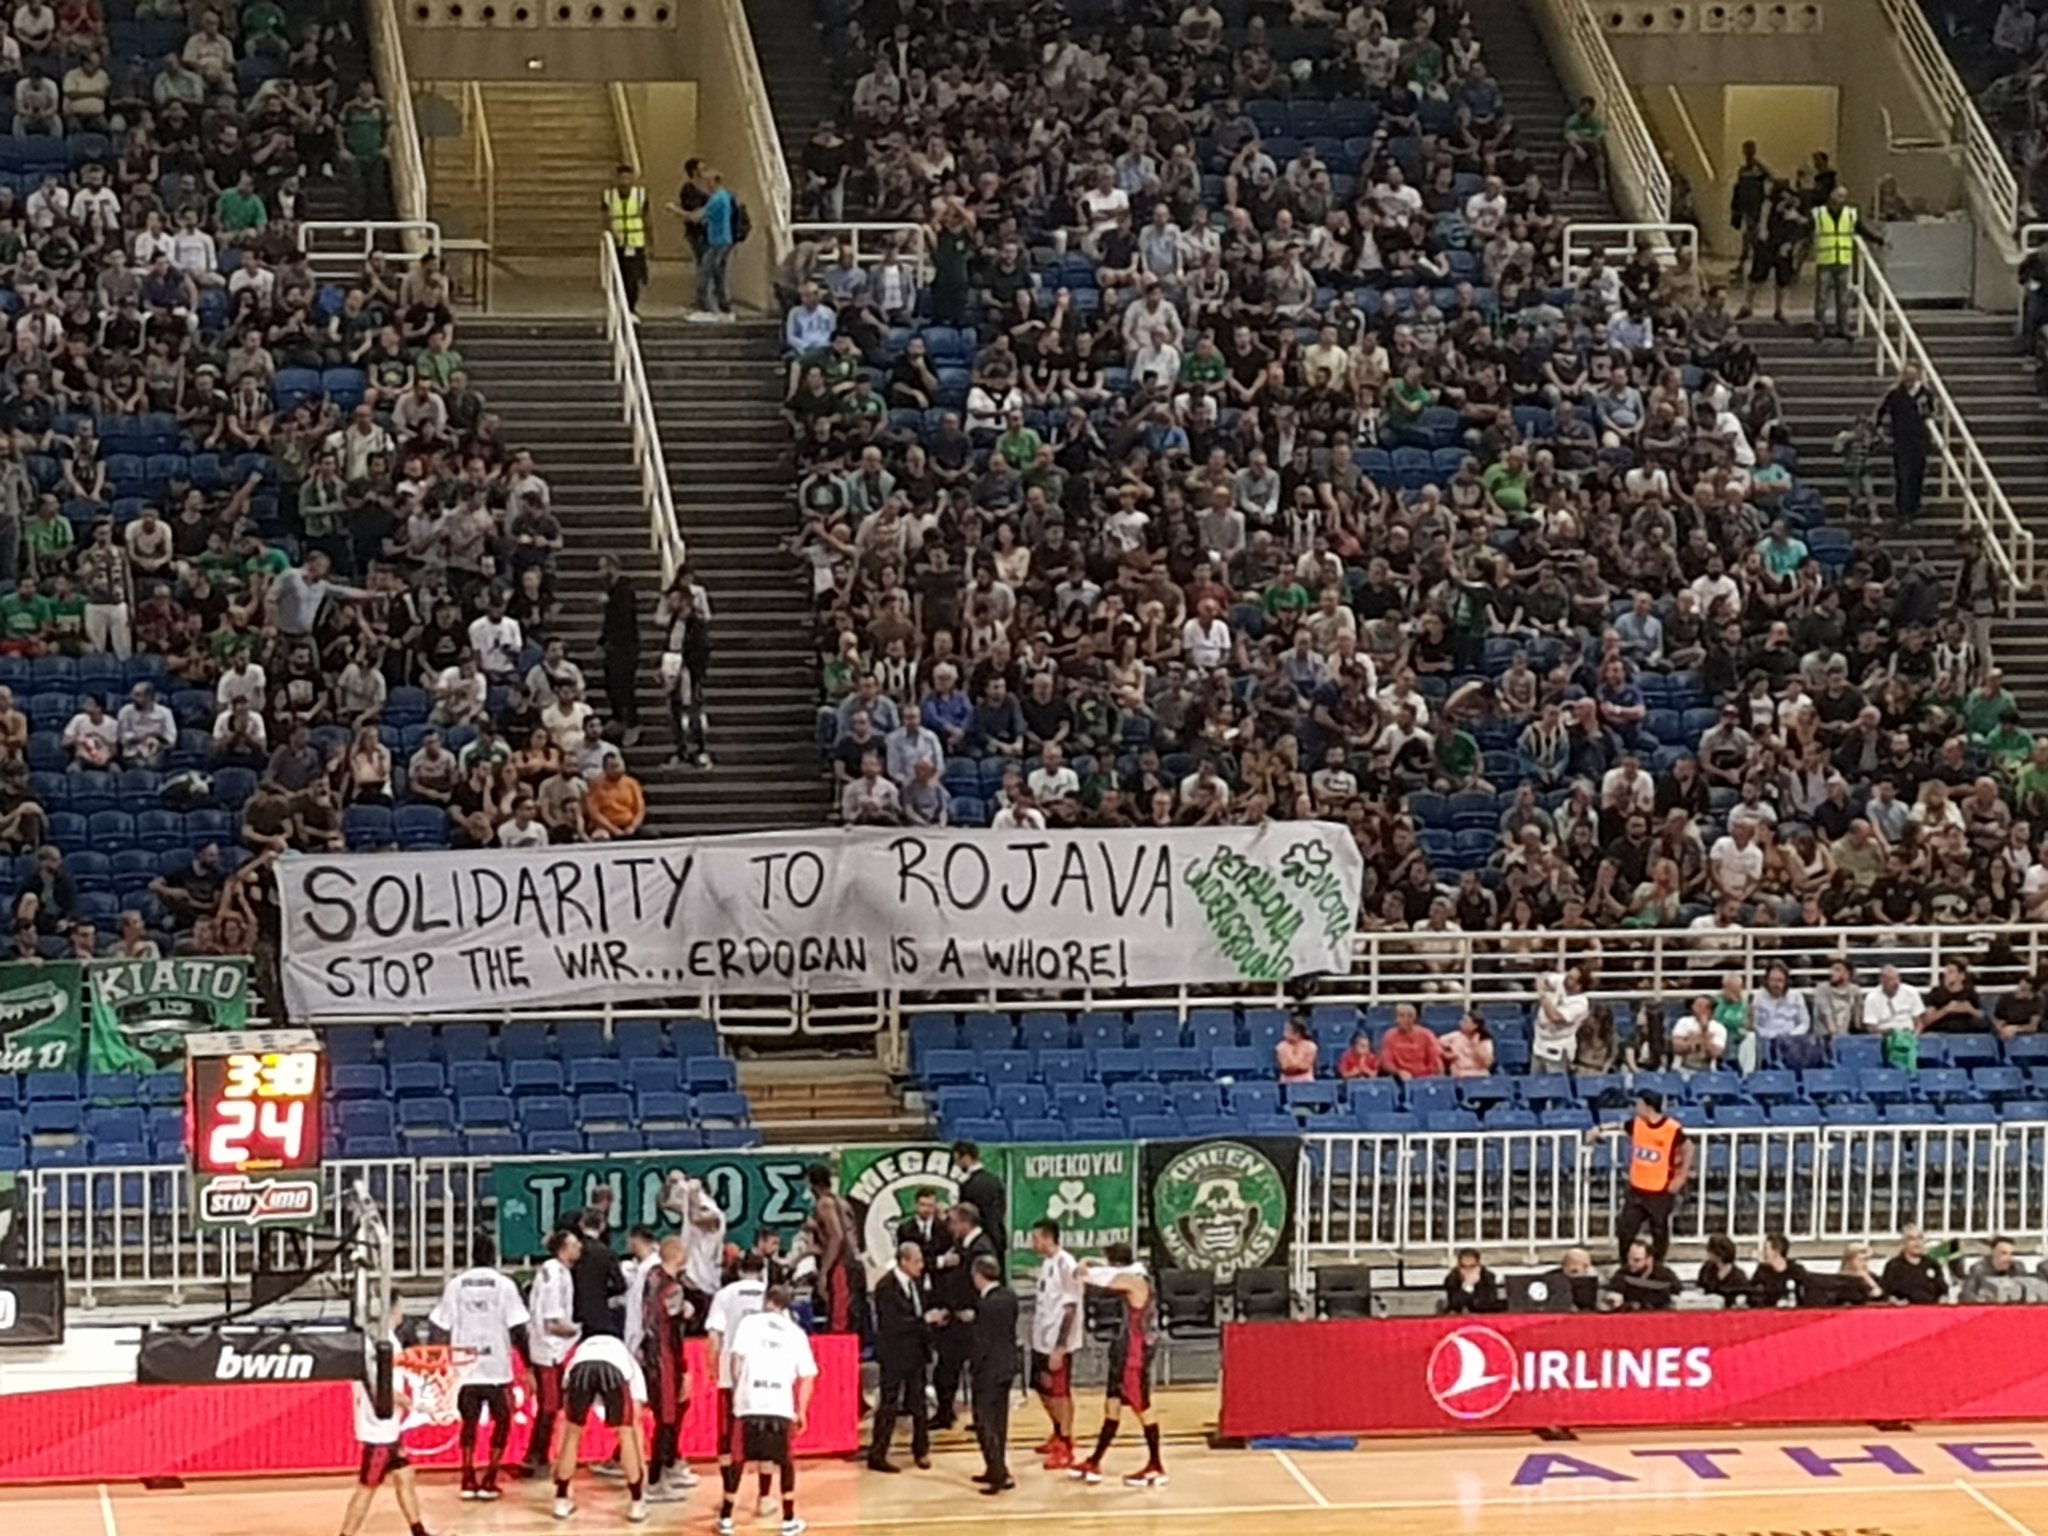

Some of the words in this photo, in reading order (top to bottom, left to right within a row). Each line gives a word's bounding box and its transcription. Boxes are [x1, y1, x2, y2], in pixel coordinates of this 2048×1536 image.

[304, 856, 693, 941] SOLIDARITY
[751, 852, 823, 909] TO
[889, 837, 1173, 927] ROJAVA
[93, 960, 242, 1003] KIATO
[327, 952, 434, 997] STOP
[459, 946, 529, 990] THE
[890, 935, 918, 974] IS
[939, 937, 963, 977] A
[986, 940, 1127, 987] WHORE!
[209, 1101, 304, 1163] 24
[1170, 1150, 1265, 1181] GREEN
[217, 1344, 313, 1379] bwin
[1511, 1346, 1713, 1391] IRLINES
